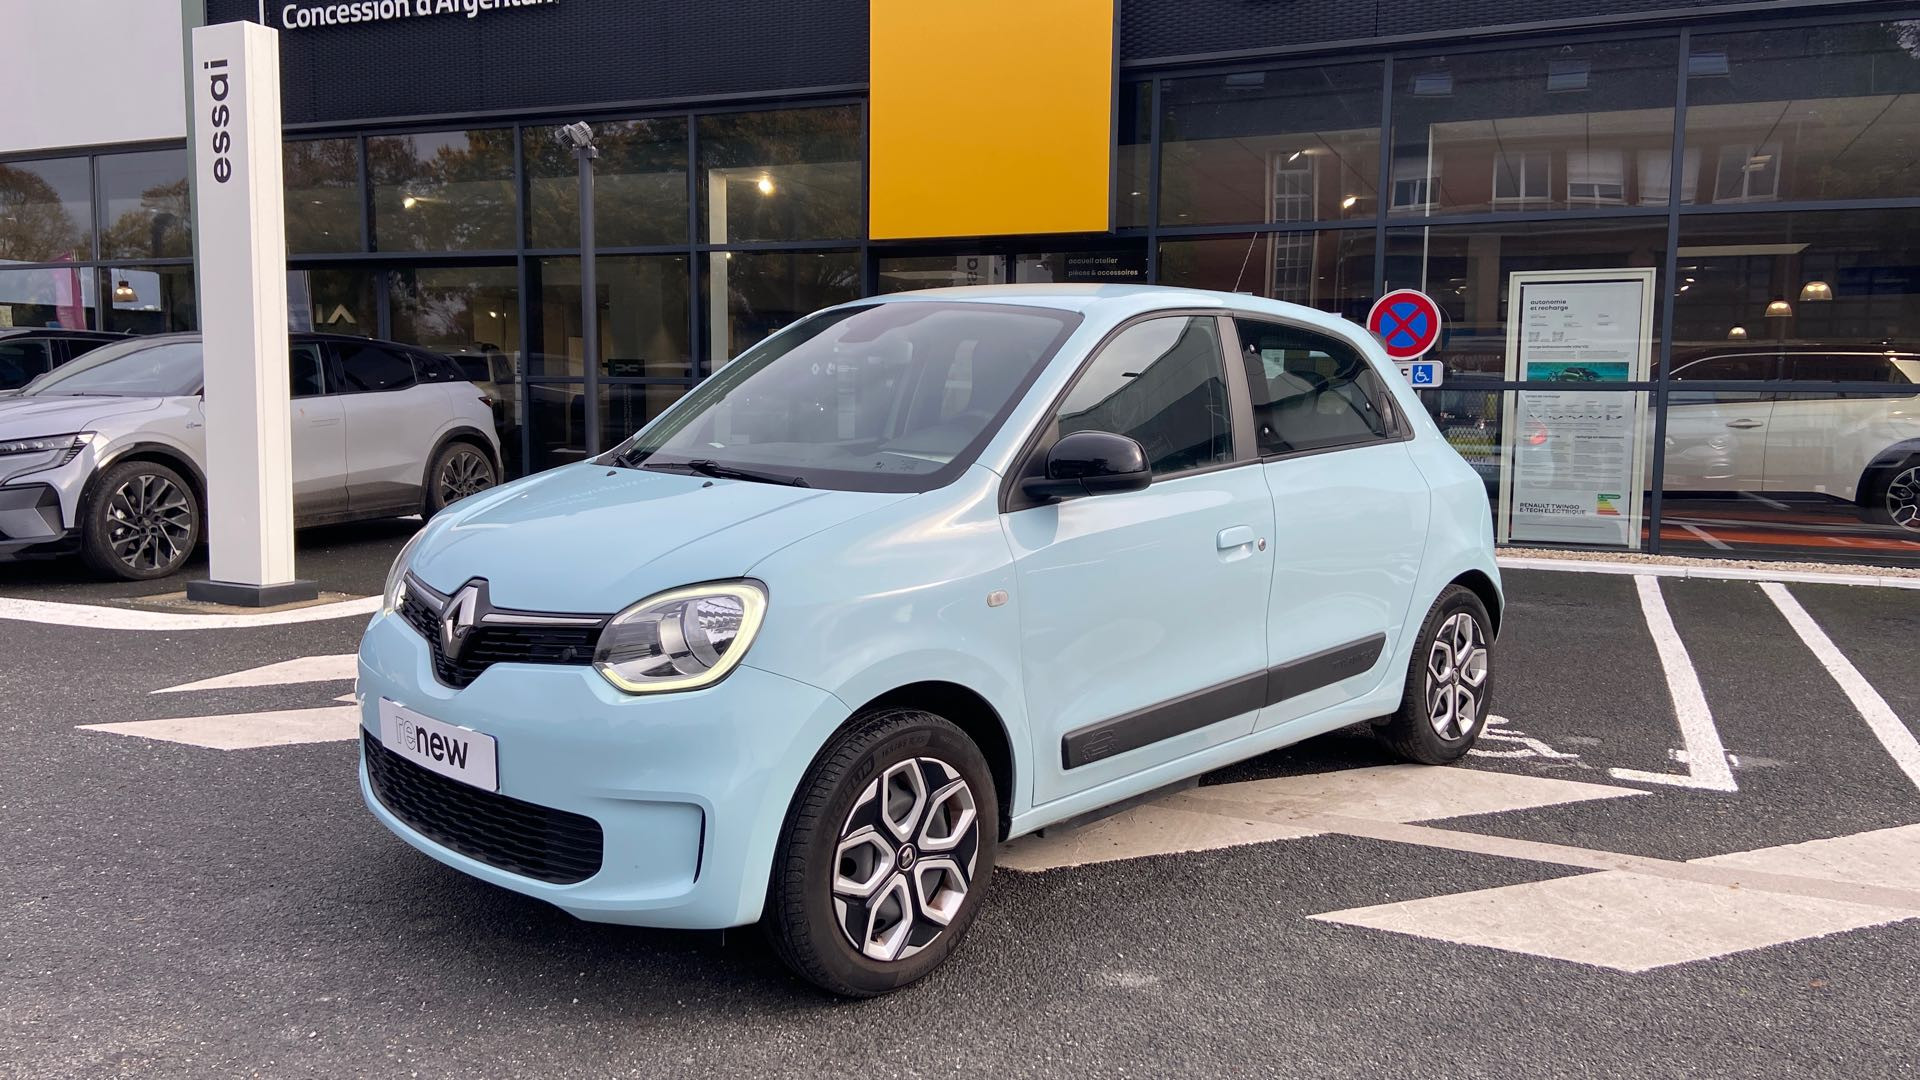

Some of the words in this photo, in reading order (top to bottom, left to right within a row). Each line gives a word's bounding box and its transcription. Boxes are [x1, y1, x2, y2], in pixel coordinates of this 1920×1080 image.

[282, 0, 410, 29] Concession
[203, 59, 231, 183] essai
[395, 715, 468, 770] renew
